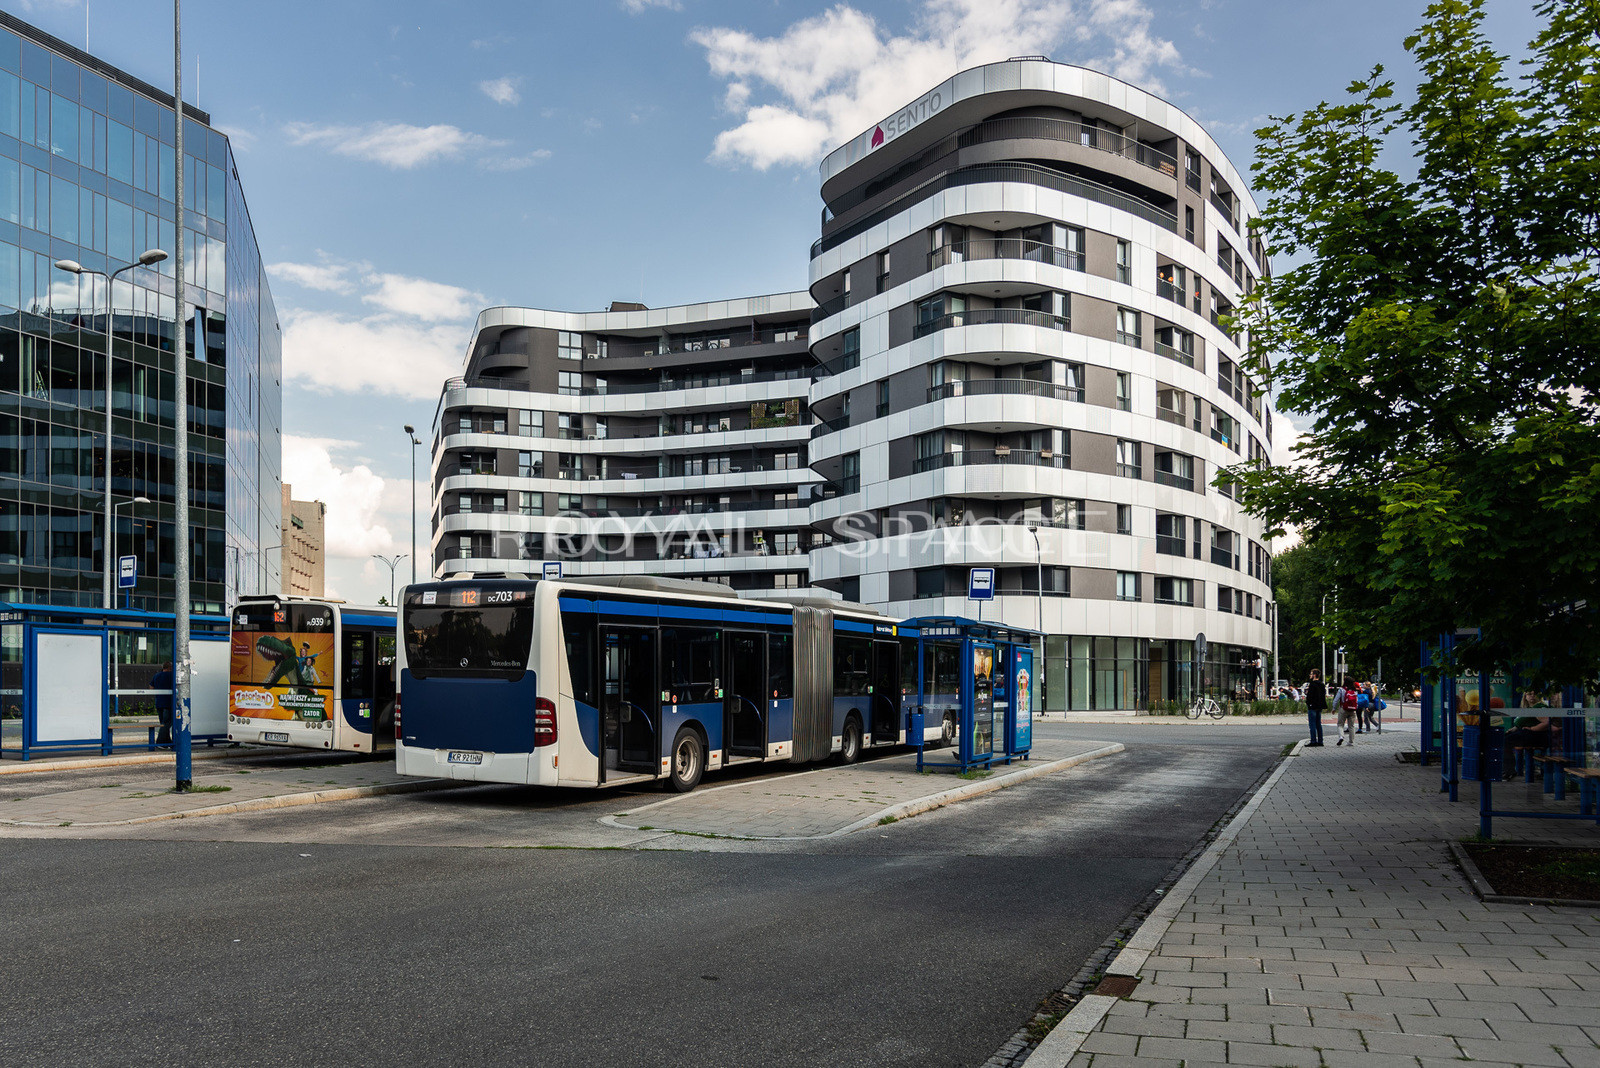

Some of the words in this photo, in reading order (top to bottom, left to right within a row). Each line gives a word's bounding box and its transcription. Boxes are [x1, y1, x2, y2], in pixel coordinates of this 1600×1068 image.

[886, 92, 942, 140] SENTO
[461, 590, 477, 604] 112
[452, 753, 462, 762] KR
